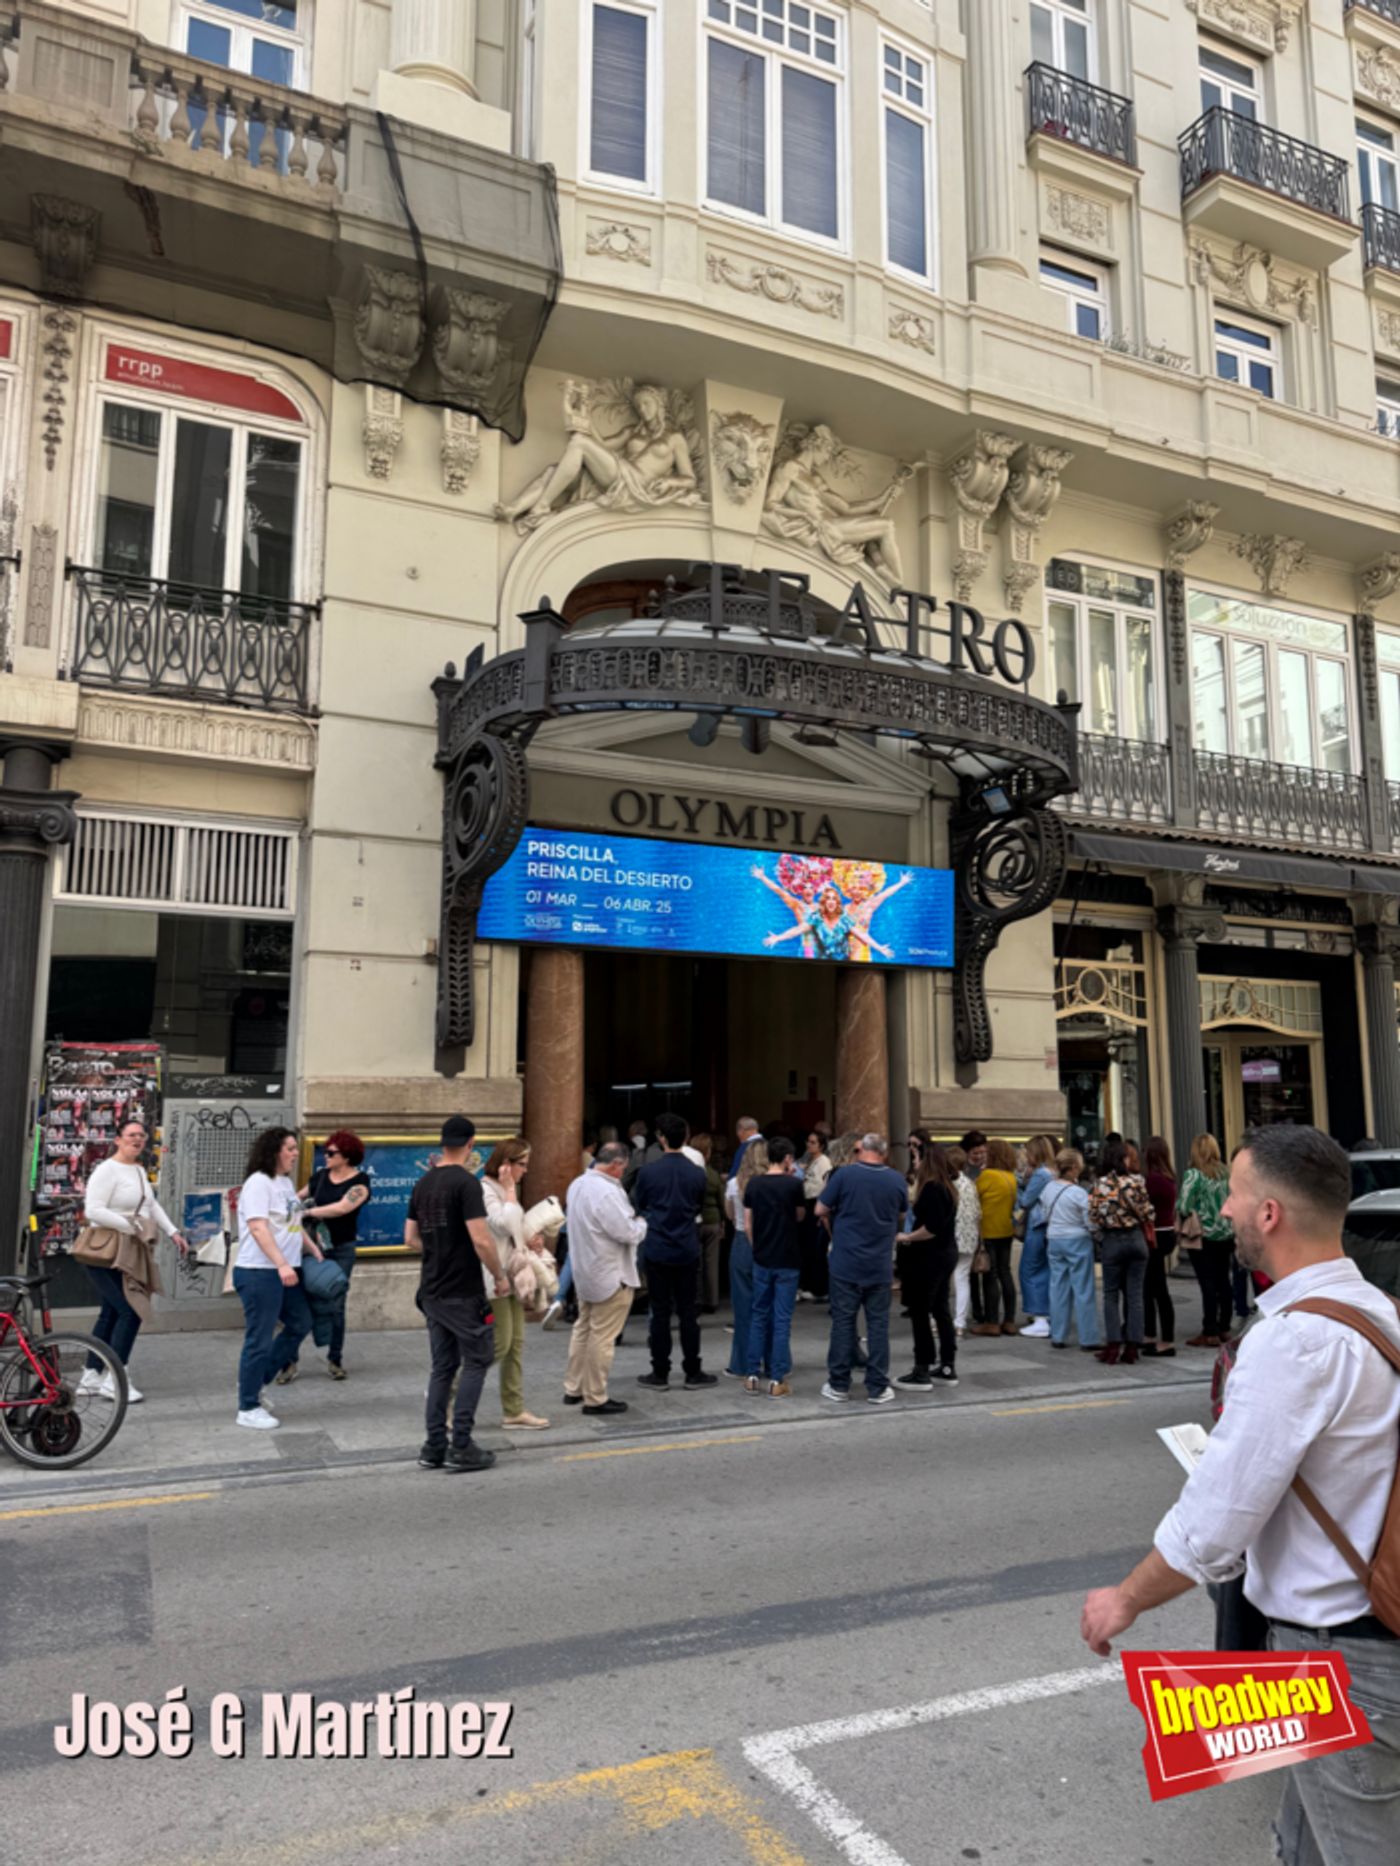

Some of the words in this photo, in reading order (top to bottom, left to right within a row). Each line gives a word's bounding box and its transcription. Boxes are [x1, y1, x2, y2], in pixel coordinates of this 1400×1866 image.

[118, 355, 163, 378] rrpp
[688, 561, 1036, 685] TEATRO
[610, 788, 843, 850] OLYMPIA
[527, 862, 578, 881] REINA
[581, 866, 612, 884] DEL
[615, 870, 693, 891] DESIERTO
[526, 890, 541, 904] 01
[546, 892, 577, 906] MAR
[604, 896, 620, 910] 06
[656, 900, 672, 914] 25
